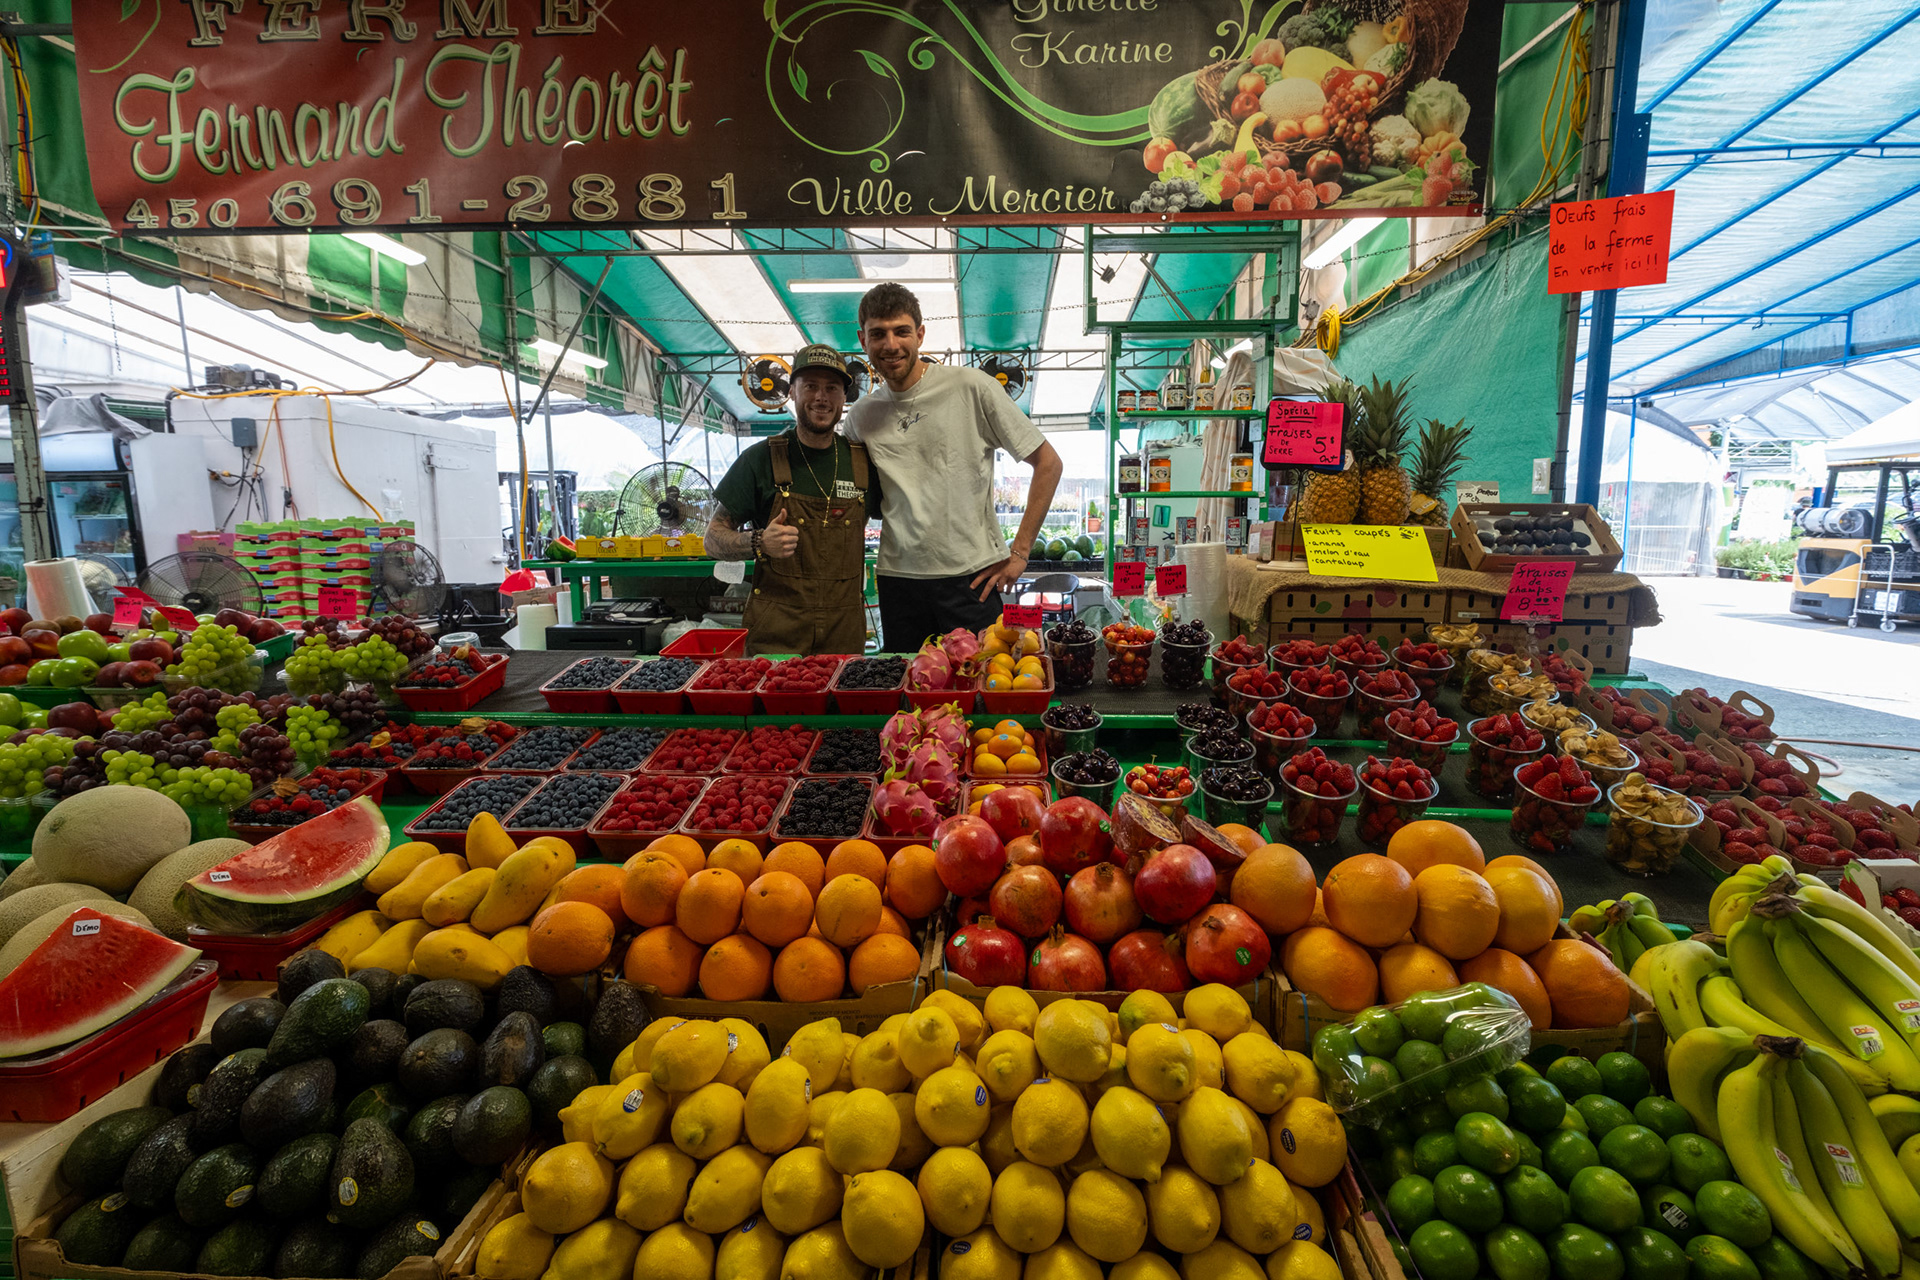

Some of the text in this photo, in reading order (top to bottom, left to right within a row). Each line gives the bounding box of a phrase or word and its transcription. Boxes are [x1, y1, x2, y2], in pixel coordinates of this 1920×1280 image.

[188, 0, 598, 47] FERME
[1010, 30, 1173, 69] Karine
[114, 41, 694, 183] Fernand Théorêt
[126, 172, 748, 230] 450 691-2881
[787, 174, 1117, 217] Ville Mercier
[1556, 199, 1646, 225] Oeufs frais
[1551, 229, 1654, 257] de la ferme
[1554, 266, 1569, 278] En
[1580, 261, 1614, 275] vente
[1277, 403, 1315, 417] Spécial
[1269, 445, 1293, 456] SERRE
[1303, 526, 1342, 536] Fruits
[1354, 528, 1391, 538] coupés
[1344, 549, 1370, 557] d'eau
[1315, 558, 1365, 568] cantaloup
[1516, 564, 1568, 579] fraises
[1508, 586, 1552, 596] champs
